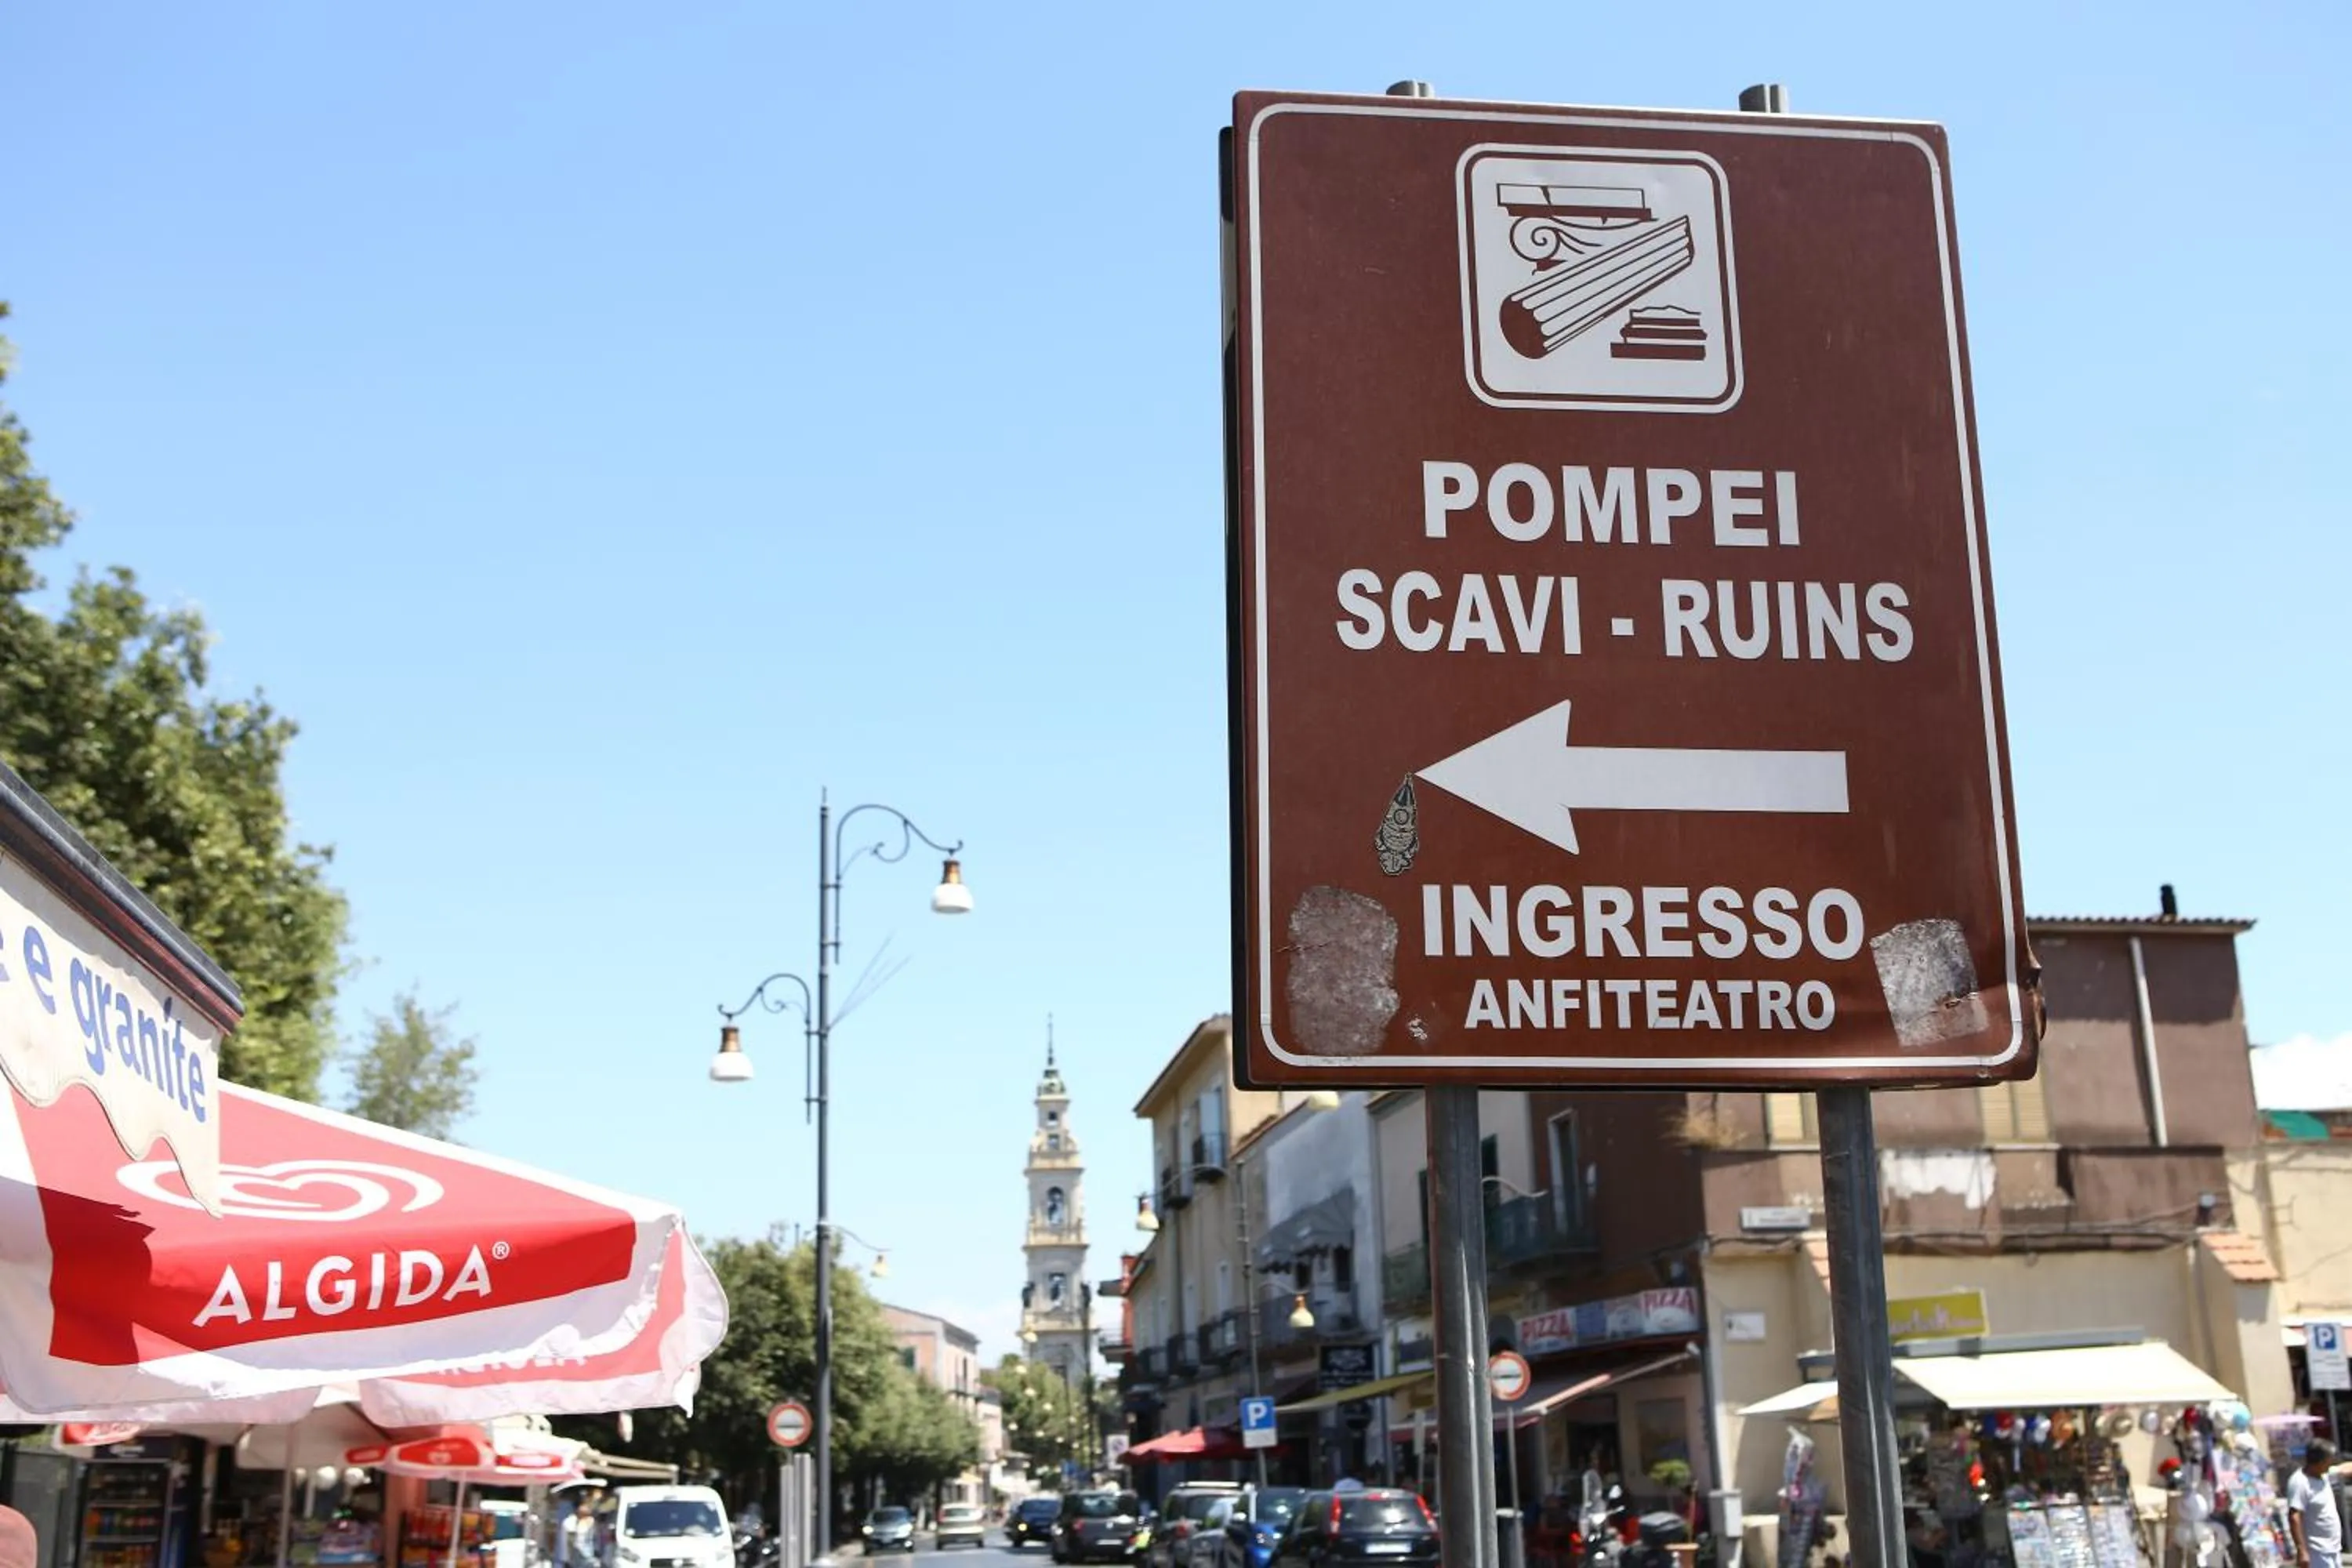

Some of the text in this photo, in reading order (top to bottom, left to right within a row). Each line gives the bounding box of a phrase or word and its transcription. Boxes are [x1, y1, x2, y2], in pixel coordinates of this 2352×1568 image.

[1423, 460, 1800, 546] POMPEI
[1336, 568, 1914, 662] SCAVI - RUINS
[1422, 884, 1864, 960] INGRESSO
[23, 926, 56, 1014] e
[70, 956, 206, 1123] granite
[1465, 979, 1835, 1030] ANFITEATRO
[1522, 1308, 1570, 1344] PIZZA
[2318, 1328, 2332, 1347] P
[1248, 1403, 1267, 1427] P
